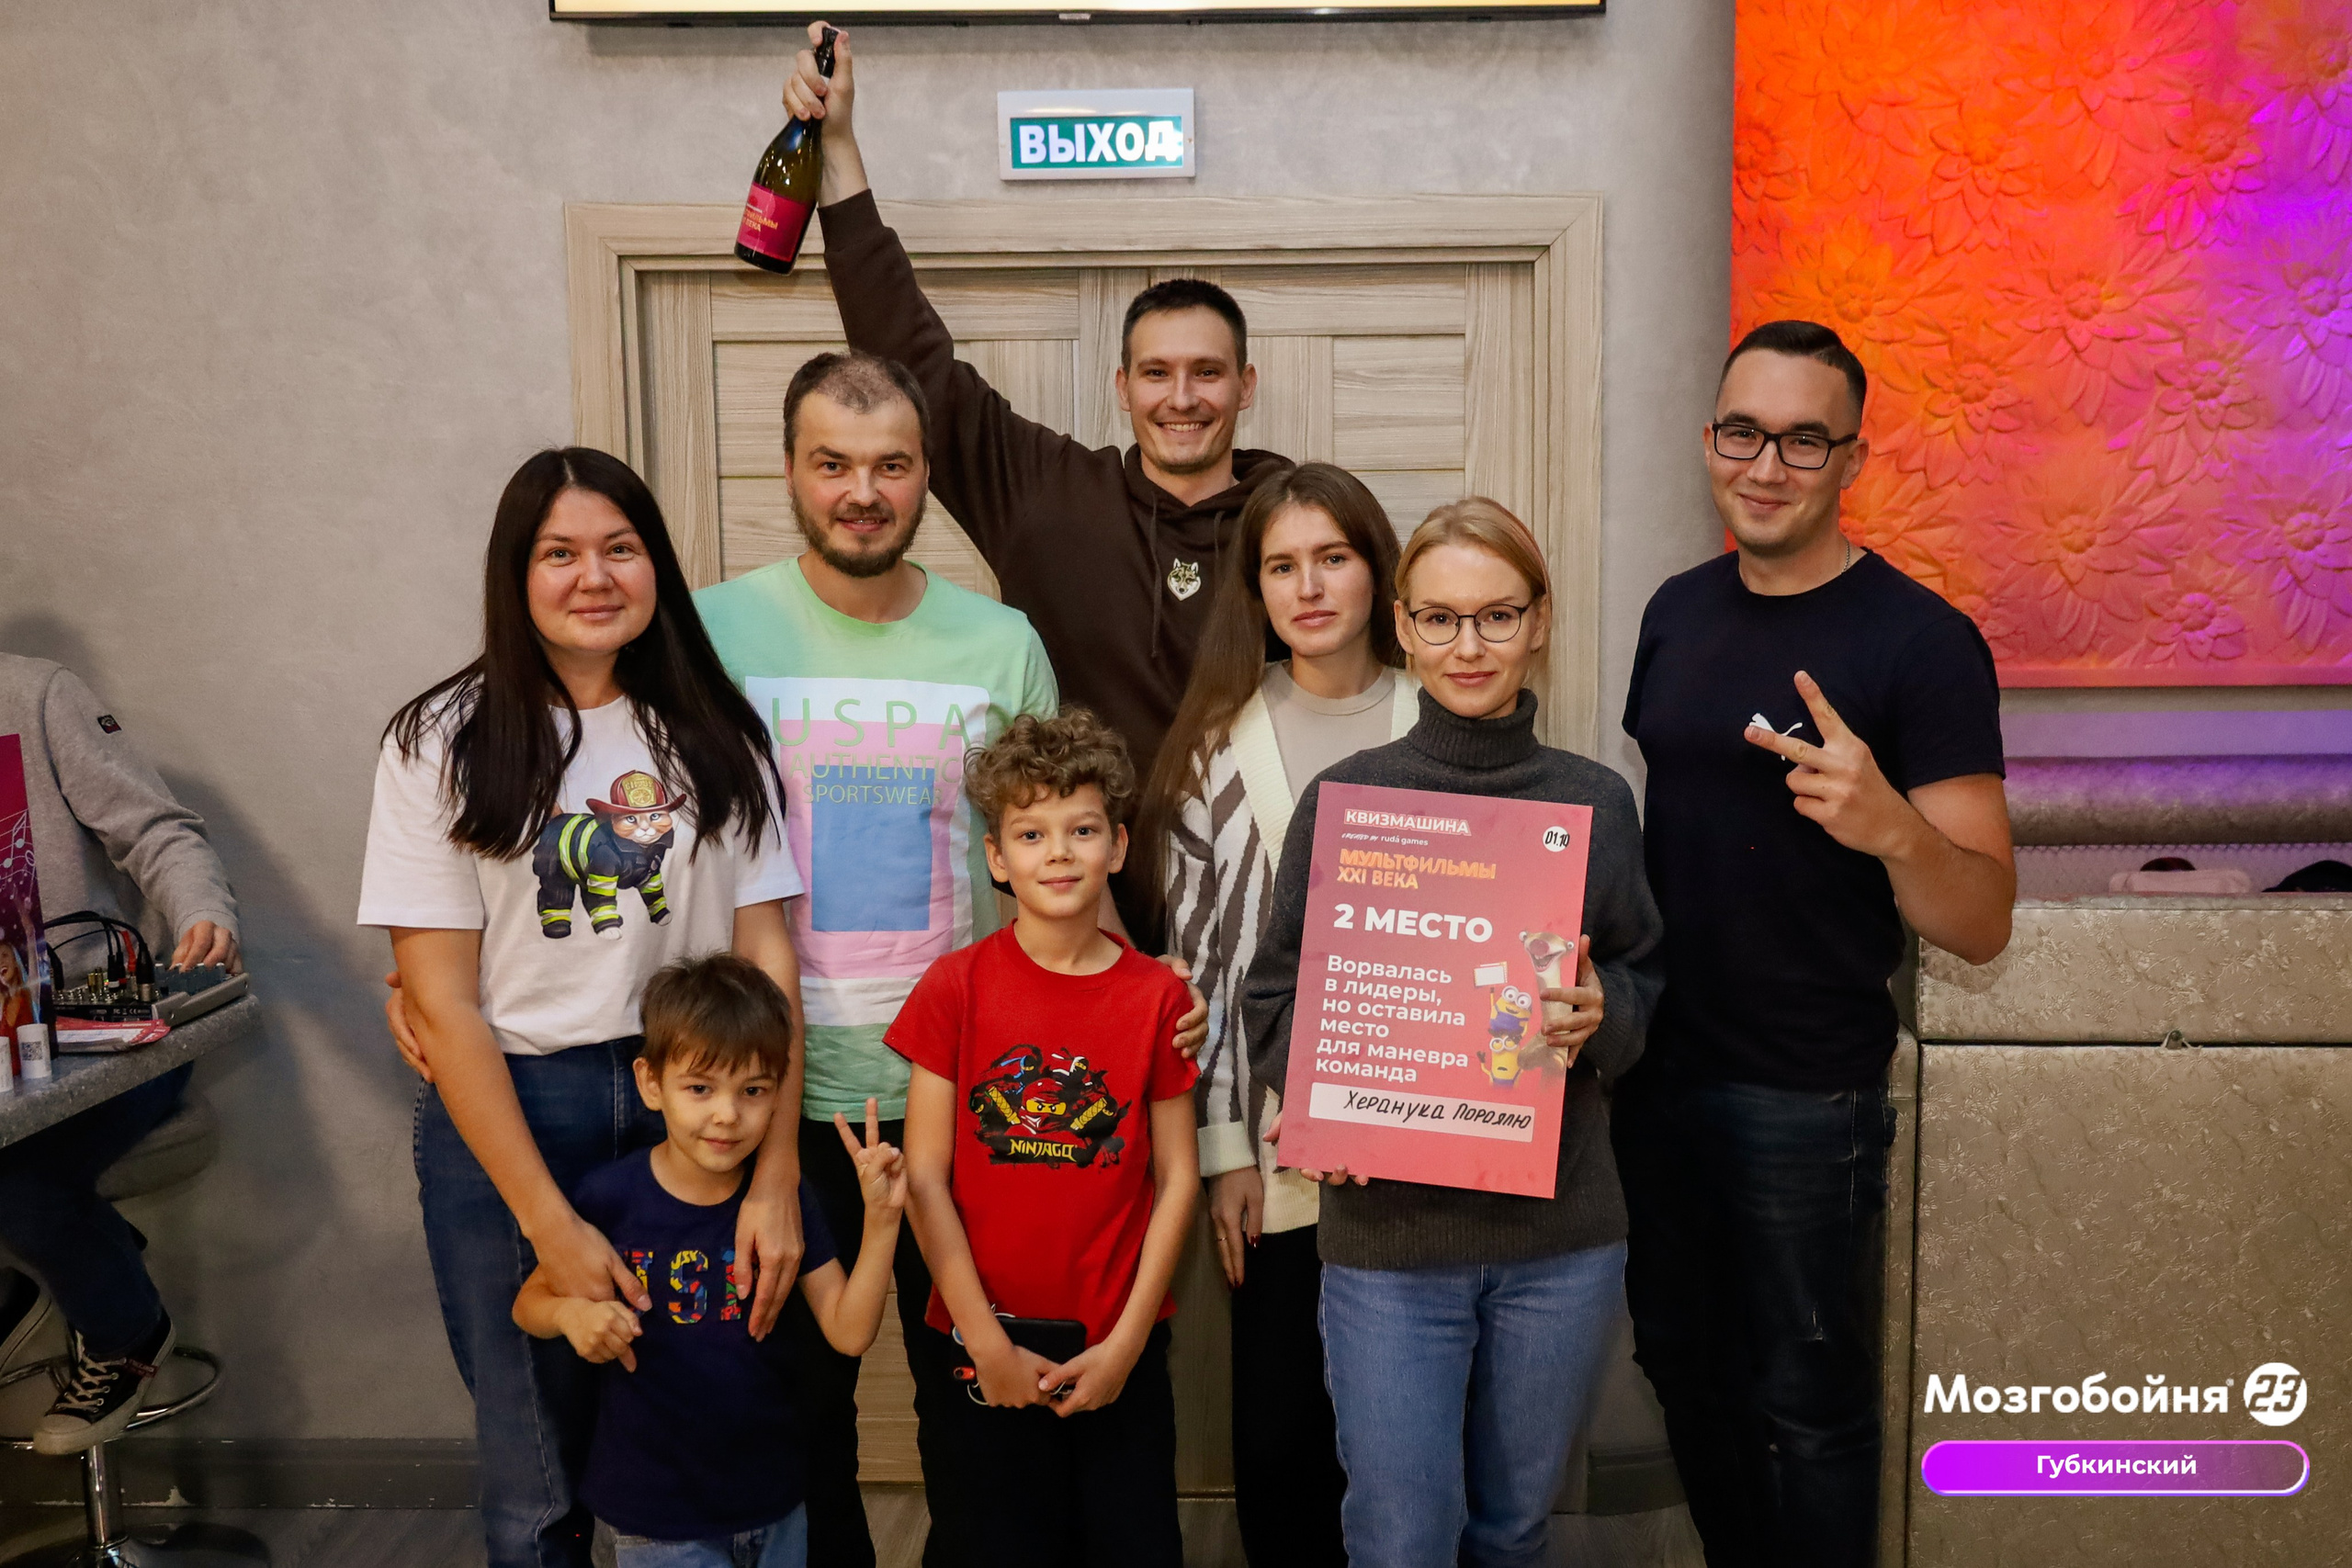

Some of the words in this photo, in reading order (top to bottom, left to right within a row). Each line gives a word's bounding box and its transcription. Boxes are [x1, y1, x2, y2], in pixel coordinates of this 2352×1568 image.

[1019, 120, 1180, 164] ВЫХОД
[789, 752, 961, 784] AUTHENTIC
[803, 784, 944, 806] SPORTSWEAR
[1345, 809, 1471, 835] КВИЗМАШИНА
[1401, 838, 1429, 846] games
[1544, 830, 1570, 848] 01.10
[1340, 848, 1497, 879] МУЛЬТФИЛЬМЫ
[1337, 866, 1367, 884] XXI
[1372, 870, 1419, 889] ВЕКА
[1333, 903, 1355, 929] 2
[1364, 906, 1493, 942] МЕСТО
[1328, 954, 1453, 984] Ворвалась
[1325, 978, 1338, 992] в
[1343, 979, 1442, 1007] лидеры,
[1322, 998, 1351, 1013] но
[1357, 1002, 1465, 1026] оставила
[1320, 1018, 1390, 1038] место
[1317, 1038, 1361, 1055] для
[1367, 1043, 1468, 1069] маневра
[1316, 1058, 1418, 1083] команда
[1007, 1139, 1077, 1162] NINJAGO
